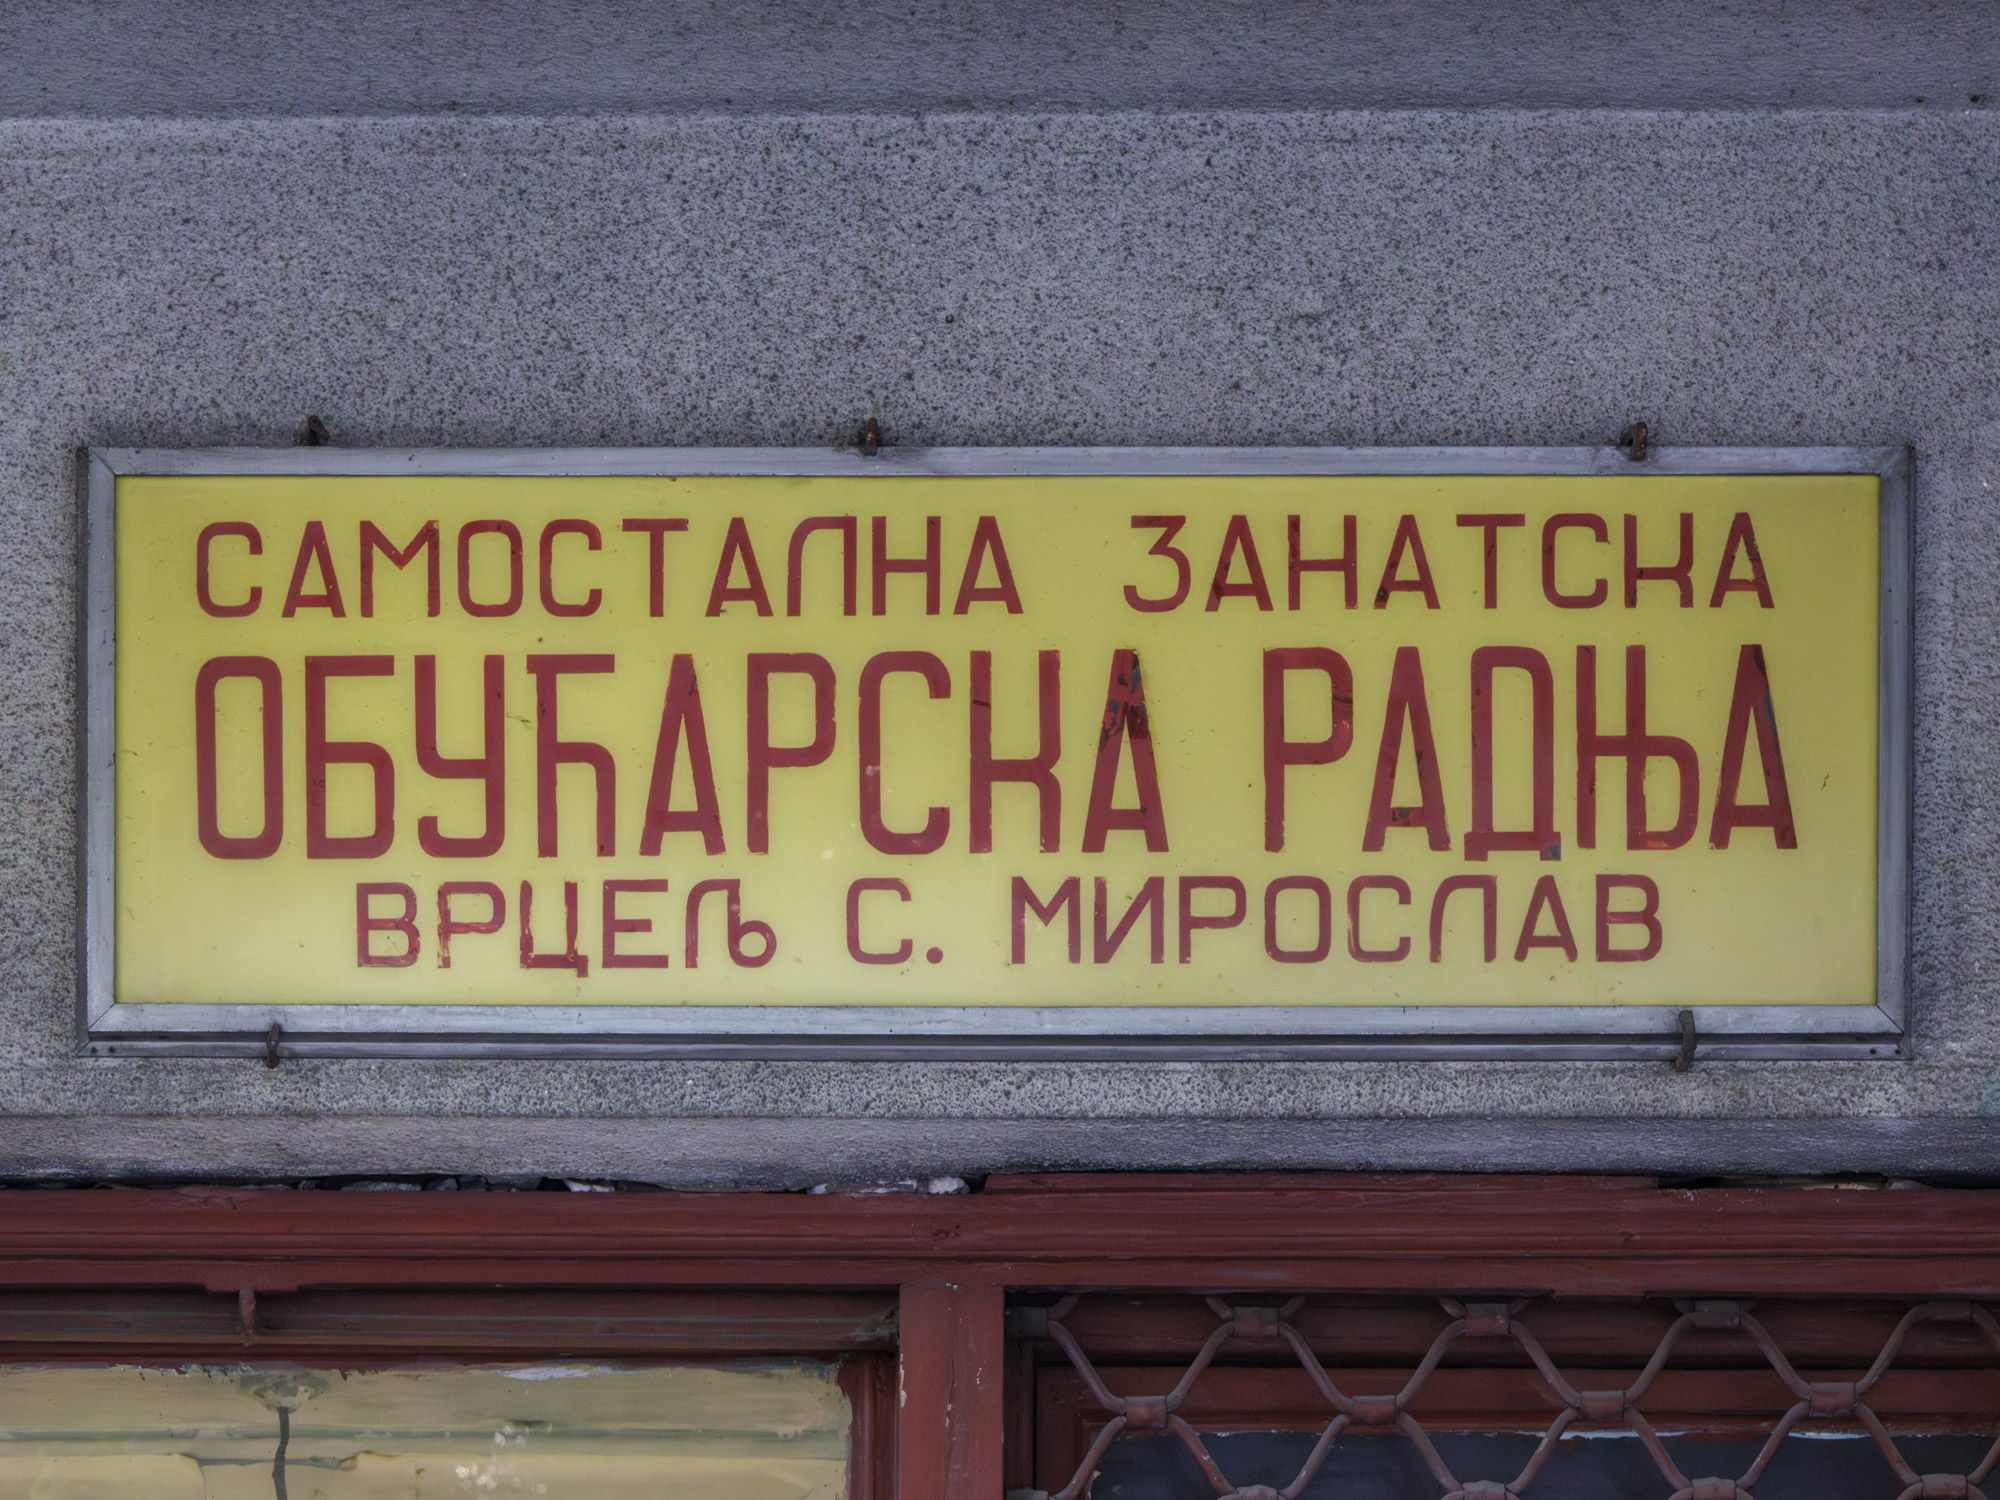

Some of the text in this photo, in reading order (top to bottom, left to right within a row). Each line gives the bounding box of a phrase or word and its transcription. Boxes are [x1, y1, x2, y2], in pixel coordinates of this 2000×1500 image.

[195, 511, 1776, 619] САМОСТАЛНА ЗАНАТСКА
[194, 643, 1799, 863] ОБУЋАРСКА РАДЊА
[356, 873, 1663, 979] ВРЦЕЉ С. МИРОСЛАВ
